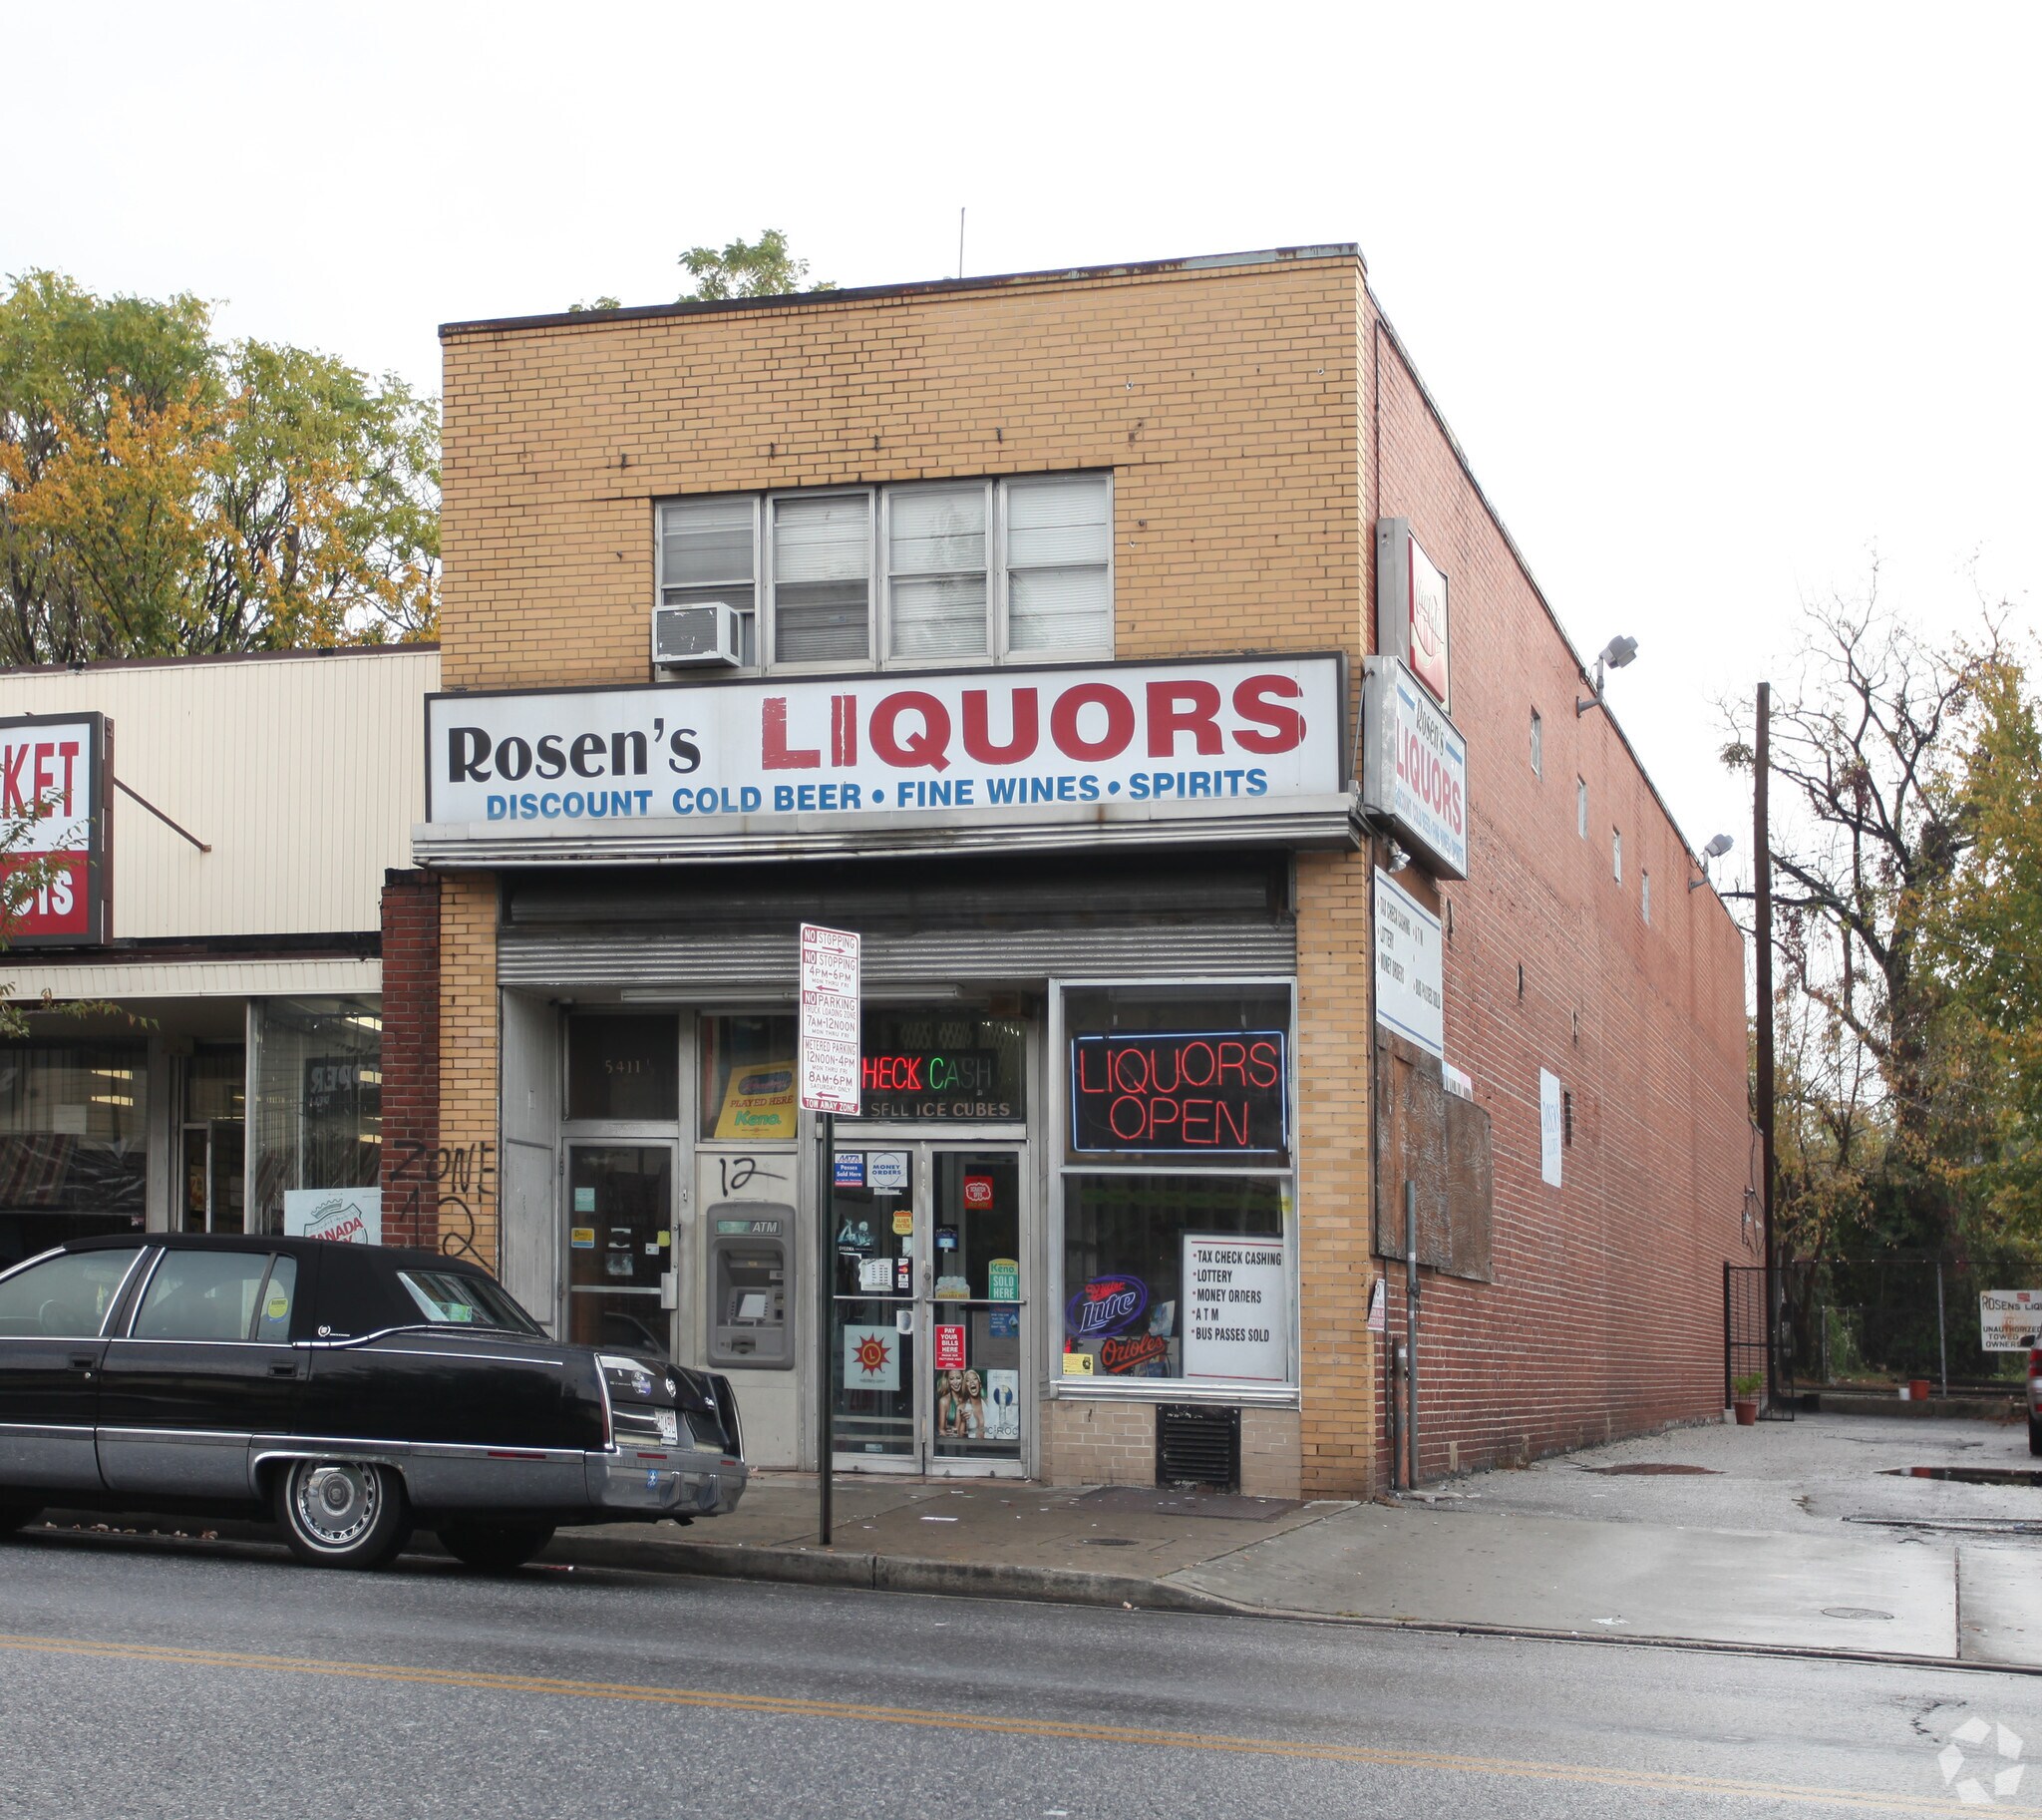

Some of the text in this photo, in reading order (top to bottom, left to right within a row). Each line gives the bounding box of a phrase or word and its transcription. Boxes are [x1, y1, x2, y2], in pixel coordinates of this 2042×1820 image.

[448, 674, 1307, 783] Rosen's LIQUORS
[1416, 698, 1444, 756] Rosen's
[1397, 716, 1462, 836] LIQUORS
[487, 769, 1267, 821] DISCOUNT COLD BEER FINE WINES SPIRITS
[805, 928, 854, 949] NO STOPPING
[805, 950, 855, 971] NO STOPPING
[809, 965, 851, 982] 4PM-6PM
[805, 991, 855, 1011] NO PARKING
[805, 1004, 821, 1014] TRUCK
[844, 1010, 856, 1020] ZONE
[805, 1039, 855, 1056] METERED PARKING
[604, 1059, 641, 1074] 5411
[929, 1057, 991, 1090] CASH
[1080, 1041, 1277, 1094] LIQUORS
[809, 1071, 852, 1087] 8AM-6PM
[730, 1095, 794, 1108] PLAYED HERE
[806, 1099, 855, 1113] TOW AWAY ZONE
[870, 1102, 1010, 1117] SELL ICE CUBES
[1110, 1095, 1248, 1146] OPEN
[388, 1140, 496, 1203] ZONE
[719, 1157, 788, 1198] 12
[752, 1222, 778, 1233] ATM
[1197, 1250, 1281, 1266] TAX CHECK CASHING
[993, 1276, 1014, 1286] SOLD
[1196, 1269, 1232, 1283] LOTTERY
[993, 1287, 1014, 1299] HERE
[1196, 1288, 1261, 1303] MONEY ORDERS
[1981, 1295, 2020, 1310] ROSENS
[1079, 1291, 1136, 1333] Lite
[1195, 1327, 1269, 1342] BUS PASSES SOLD
[1101, 1331, 1167, 1367] Orioles
